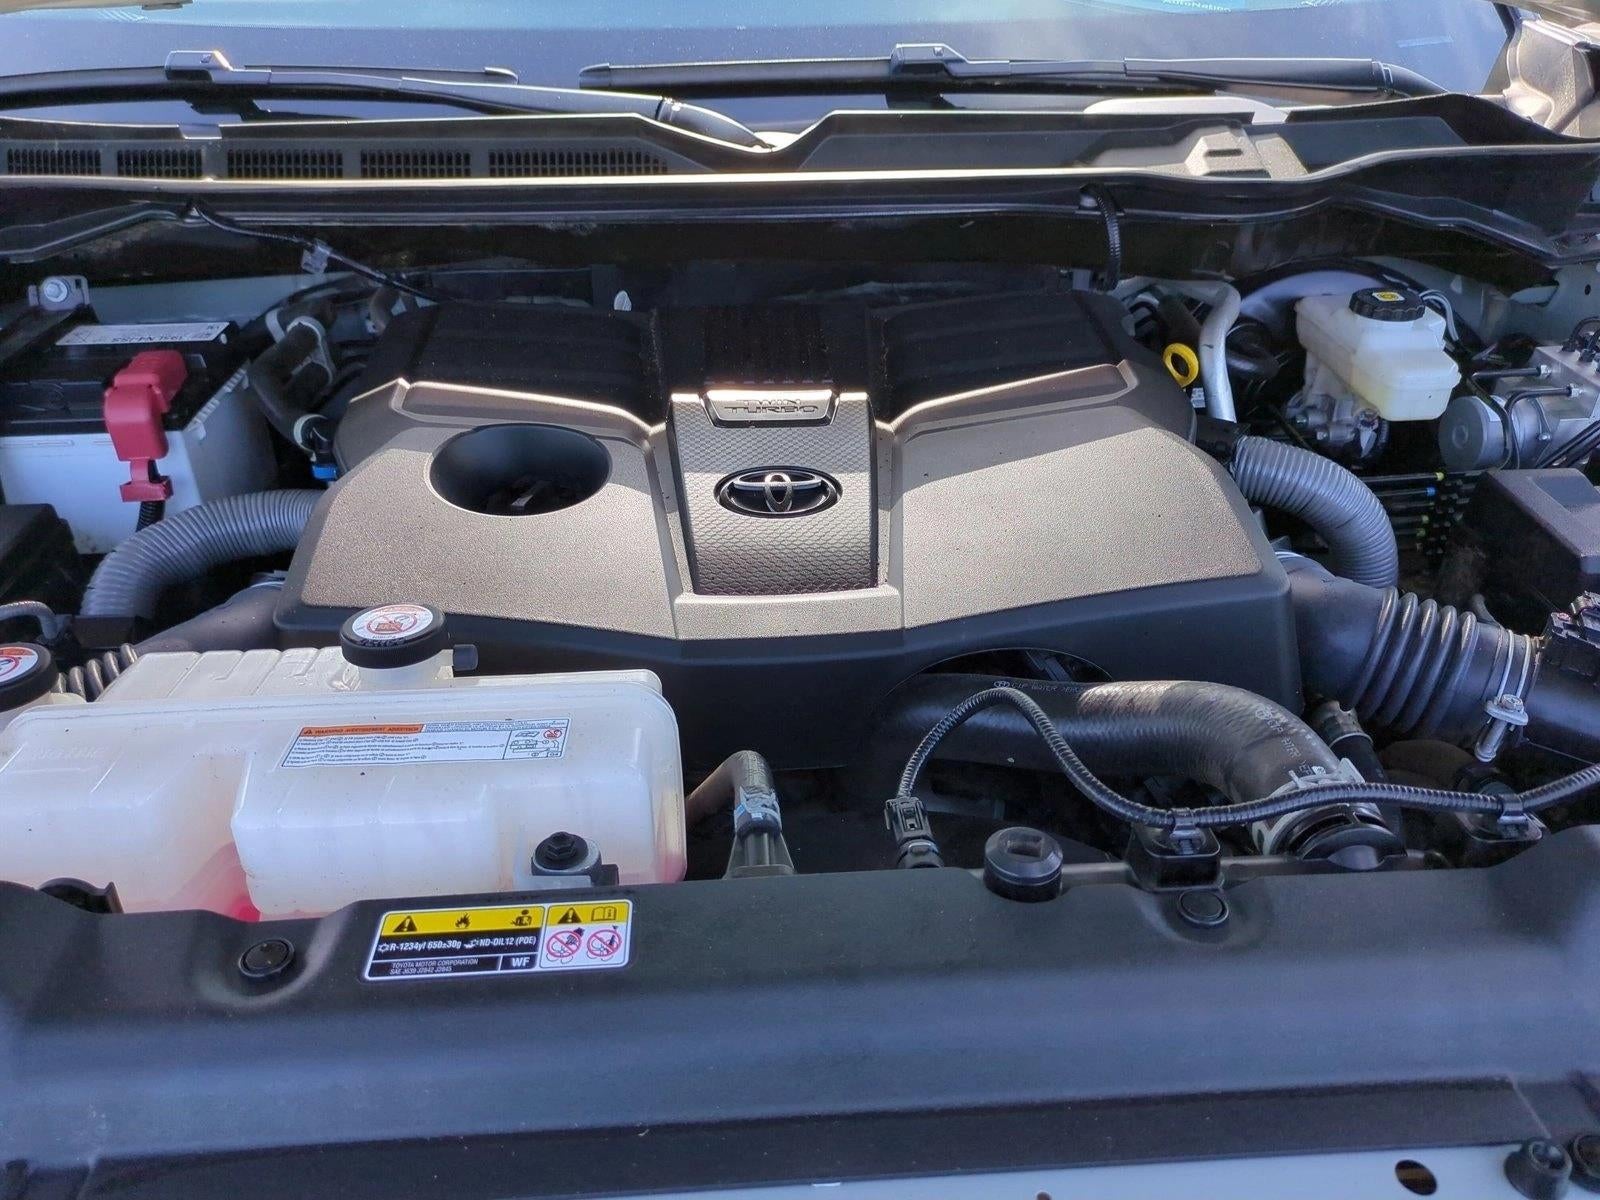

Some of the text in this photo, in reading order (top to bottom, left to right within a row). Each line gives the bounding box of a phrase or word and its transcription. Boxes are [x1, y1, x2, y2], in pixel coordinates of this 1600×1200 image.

[724, 405, 818, 414] TURBO
[415, 960, 437, 968] MOTOR
[437, 958, 479, 967] CORPORATION
[511, 956, 531, 968] WF
